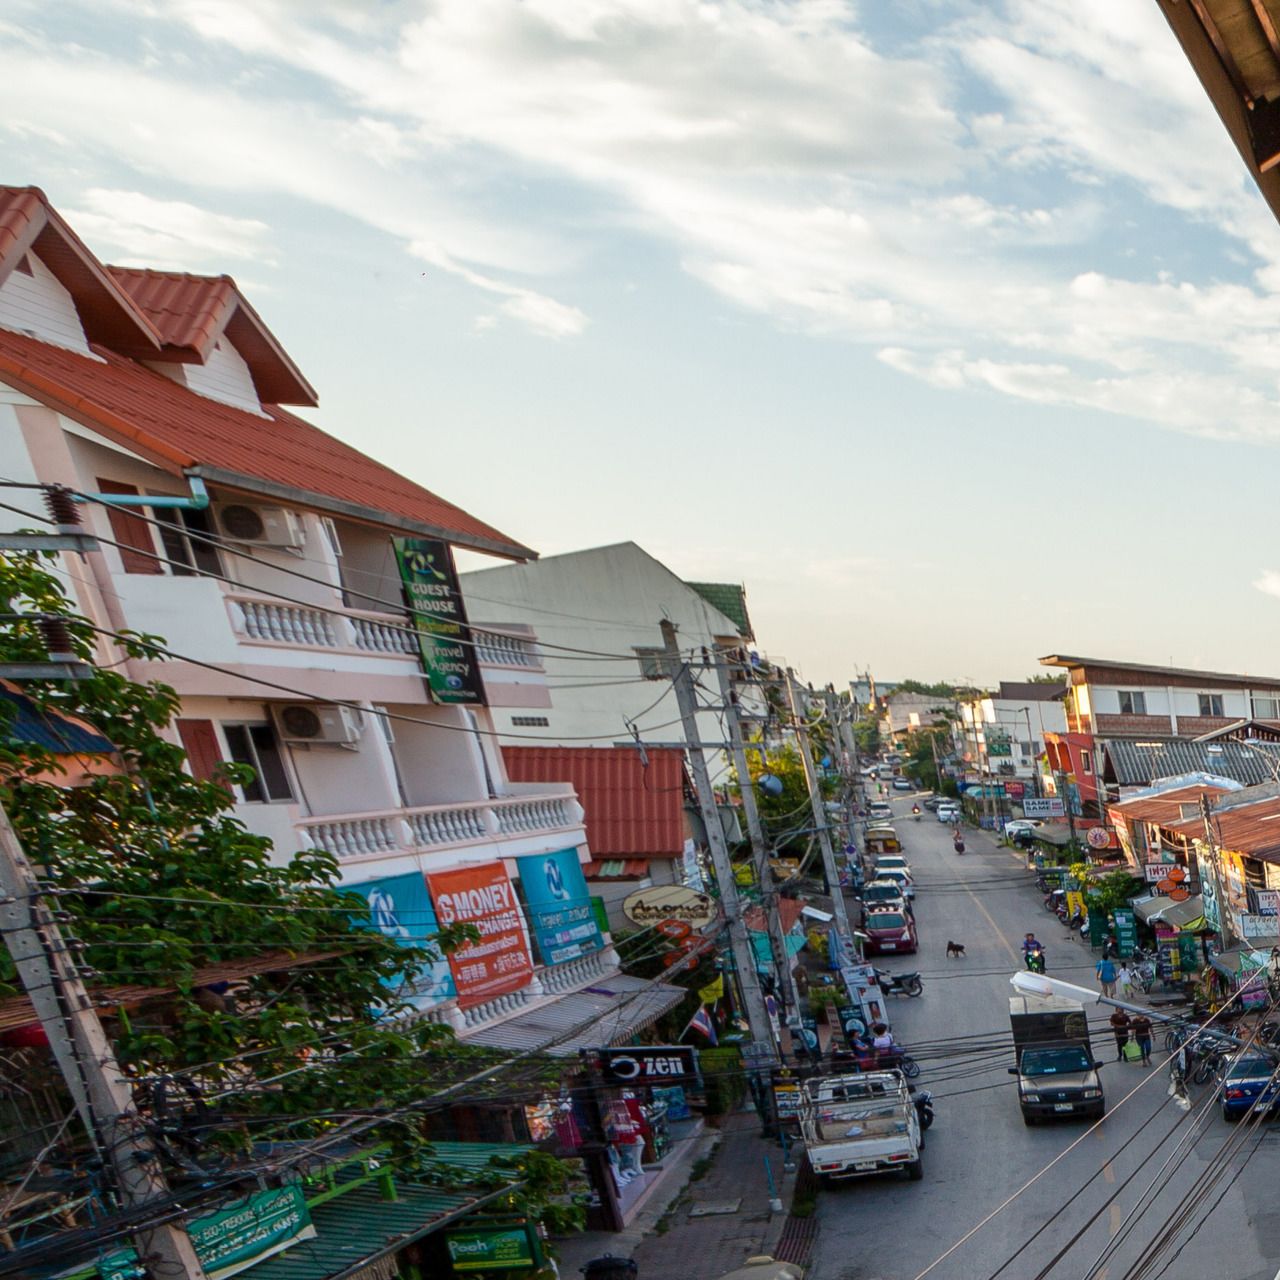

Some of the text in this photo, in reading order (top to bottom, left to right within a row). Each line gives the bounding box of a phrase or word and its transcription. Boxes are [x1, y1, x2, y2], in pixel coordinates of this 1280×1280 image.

[411, 582, 450, 597] GUEST
[414, 600, 457, 613] HOUSE
[431, 659, 470, 677] Agency
[455, 882, 510, 920] MONEY
[448, 1239, 489, 1261] Pooh
